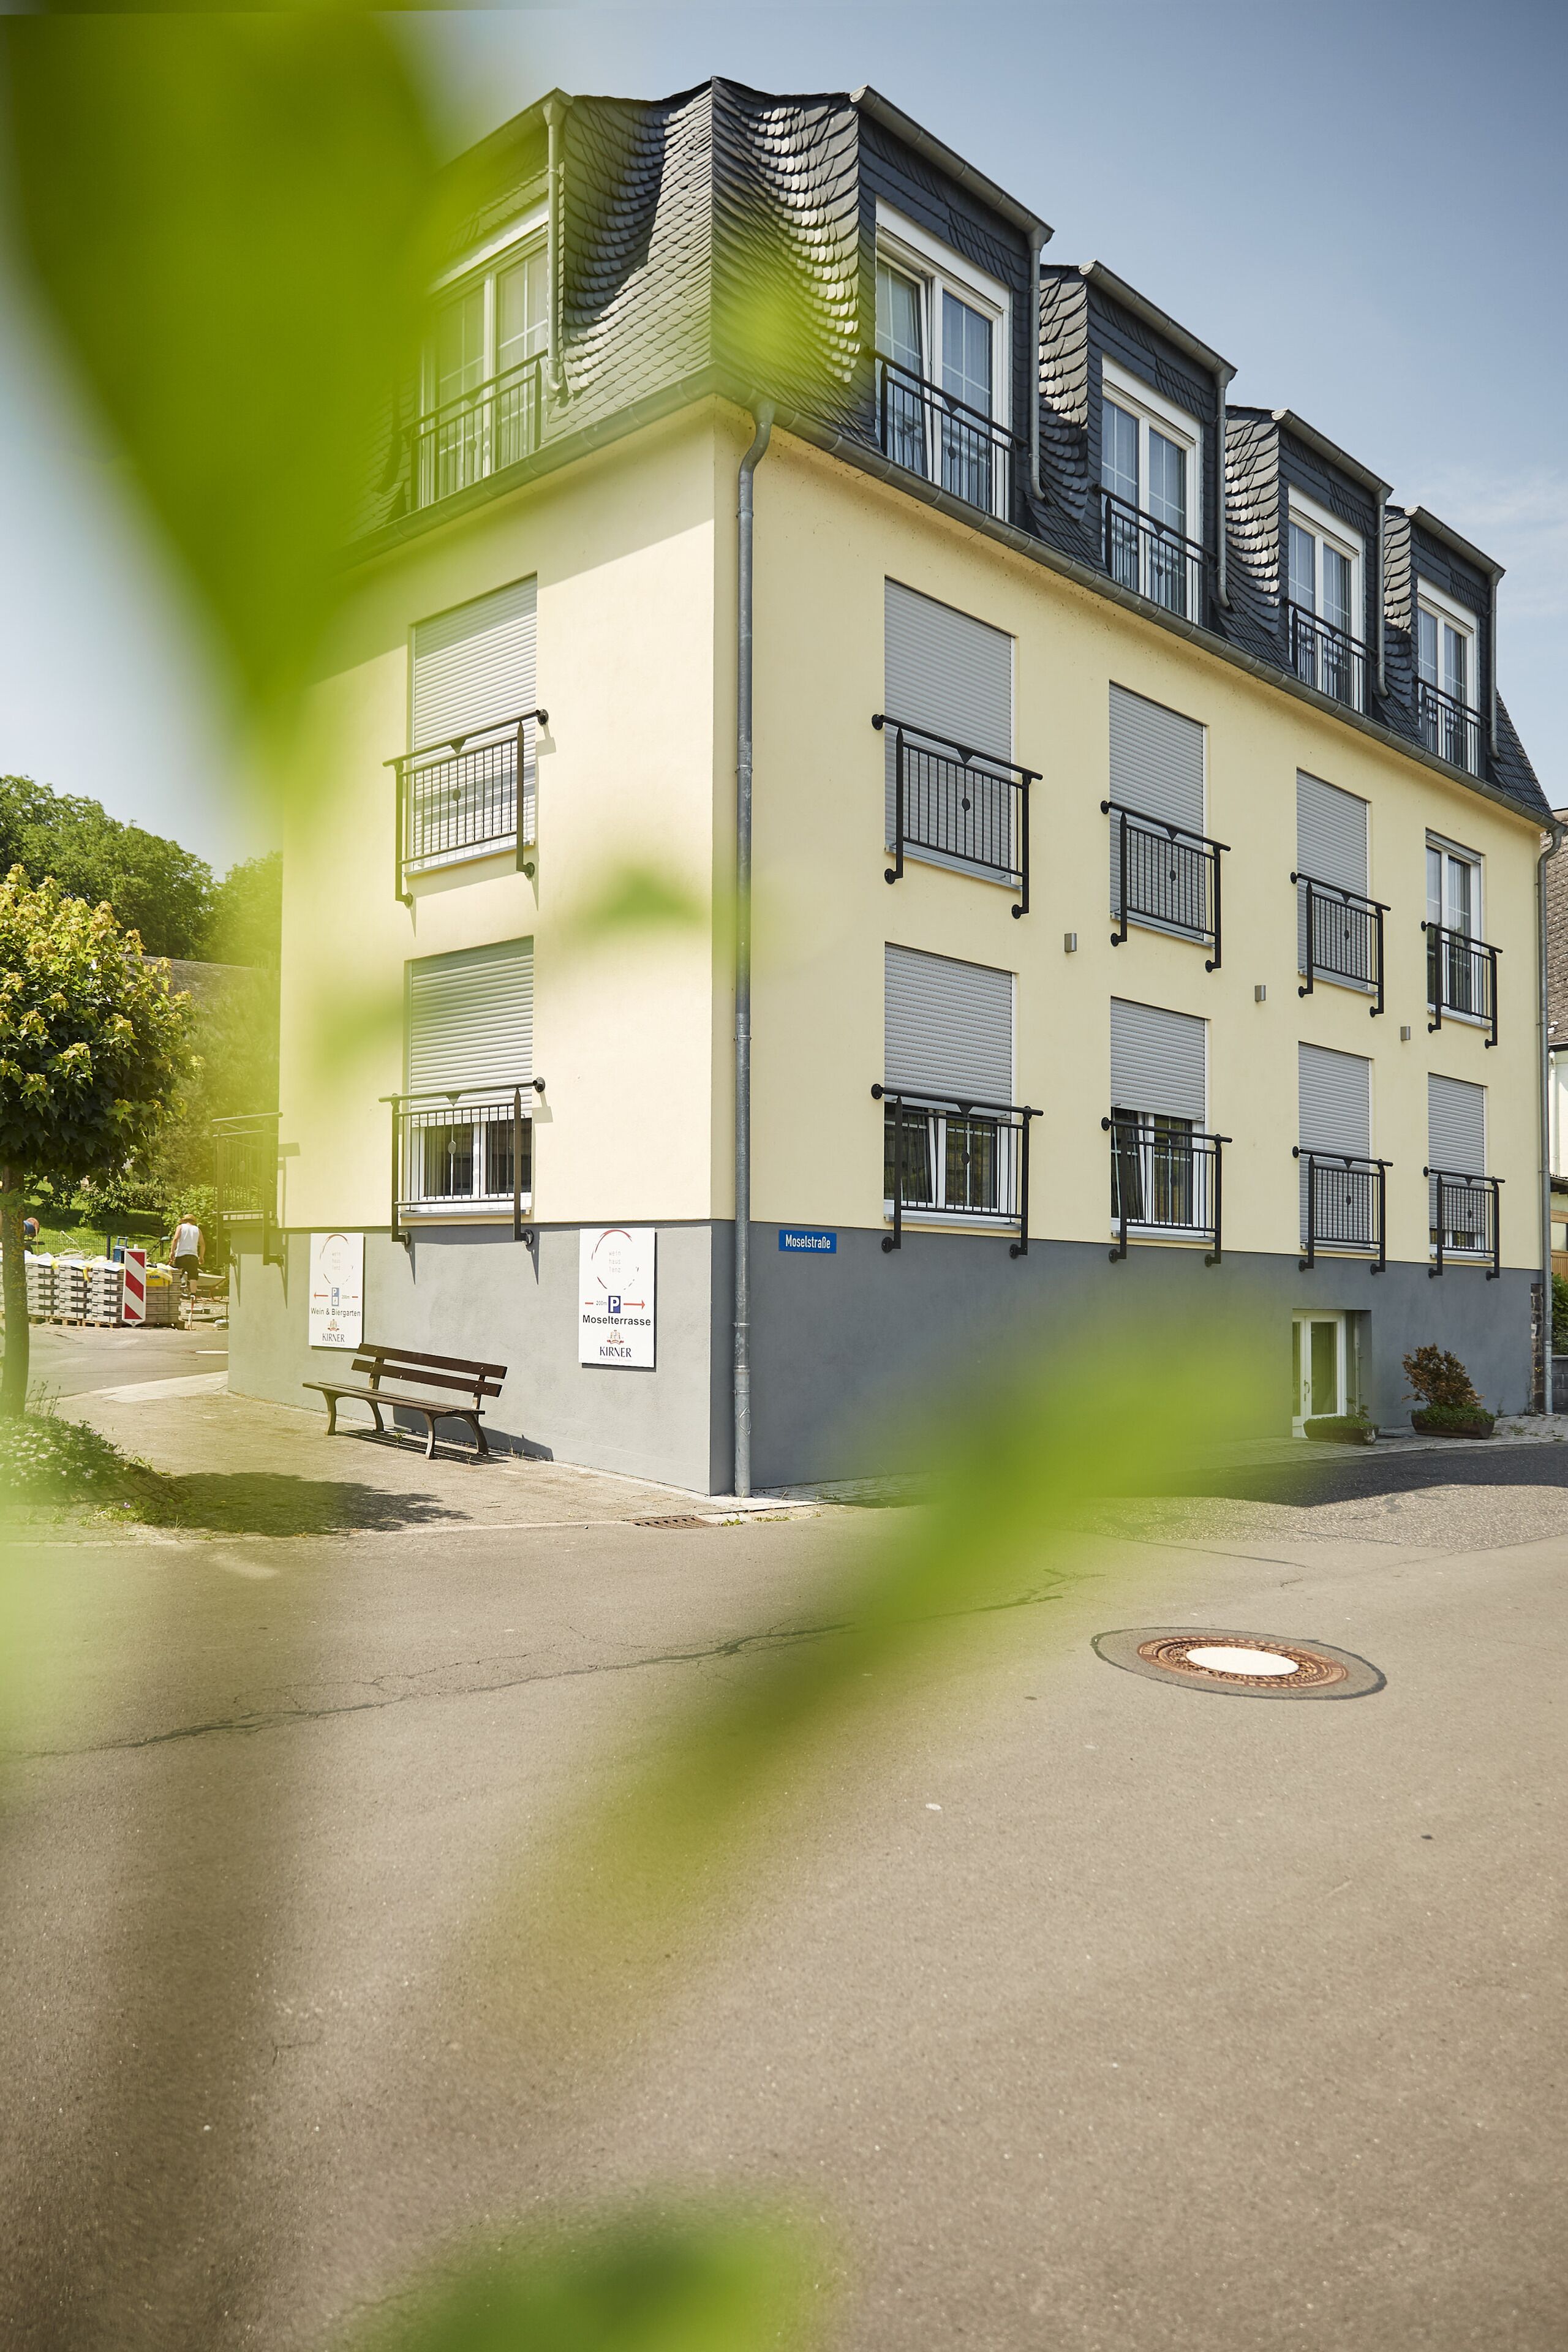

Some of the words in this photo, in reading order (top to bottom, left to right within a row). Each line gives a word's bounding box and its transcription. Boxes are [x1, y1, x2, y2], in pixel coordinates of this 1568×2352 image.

[785, 1234, 831, 1249] Moselstraße
[610, 1297, 620, 1312] P
[331, 1308, 361, 1318] Biergarten
[582, 1314, 651, 1325] Moselterrasse
[322, 1333, 345, 1343] KIRNER
[600, 1346, 631, 1358] KIRNER
